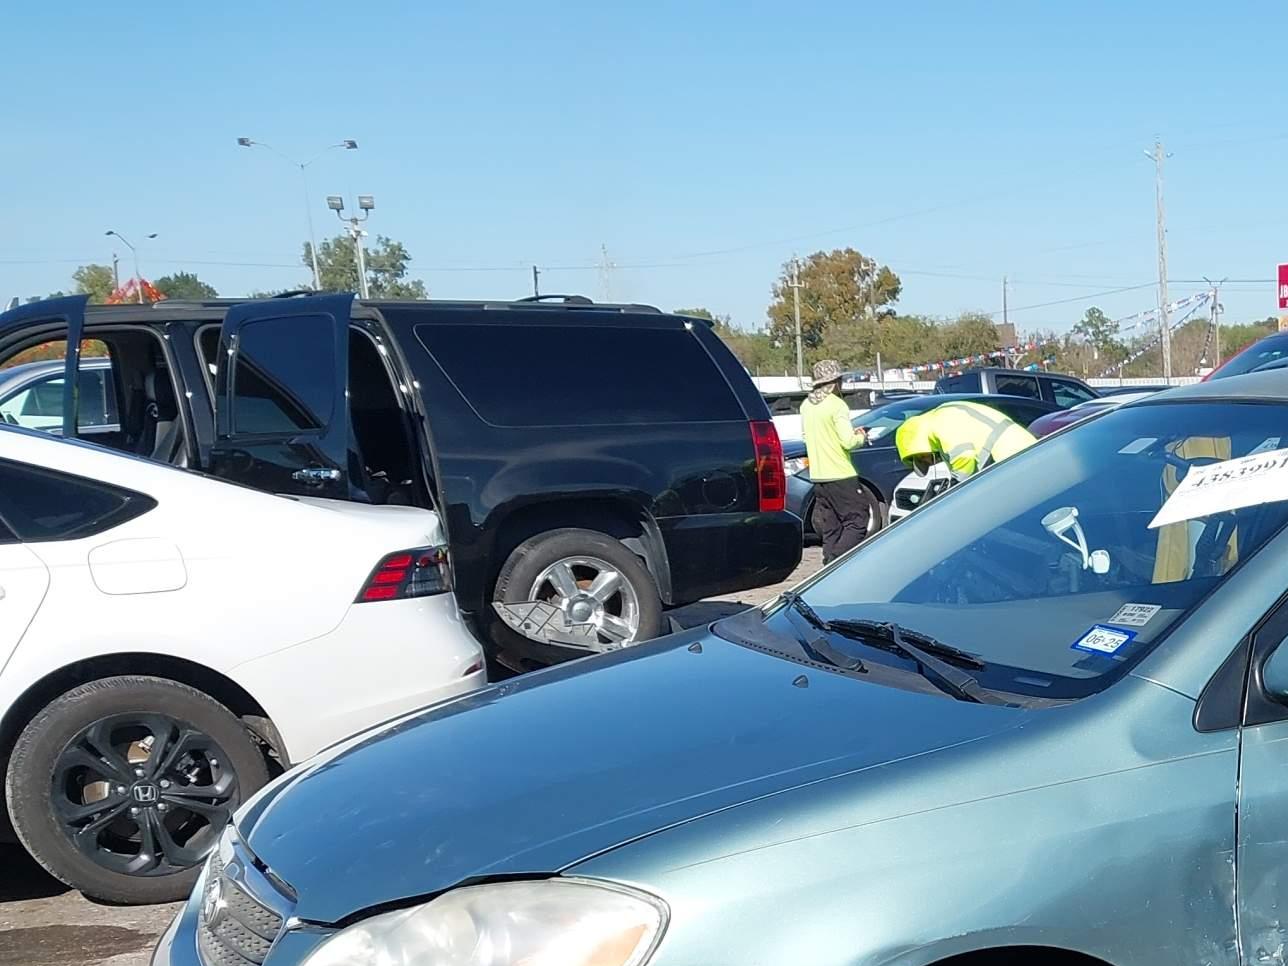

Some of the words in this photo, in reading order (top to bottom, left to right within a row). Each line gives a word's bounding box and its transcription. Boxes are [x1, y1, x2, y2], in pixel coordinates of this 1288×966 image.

[1280, 285, 1288, 298] JB
[1086, 633, 1101, 646] 06
[1104, 636, 1122, 649] 25
